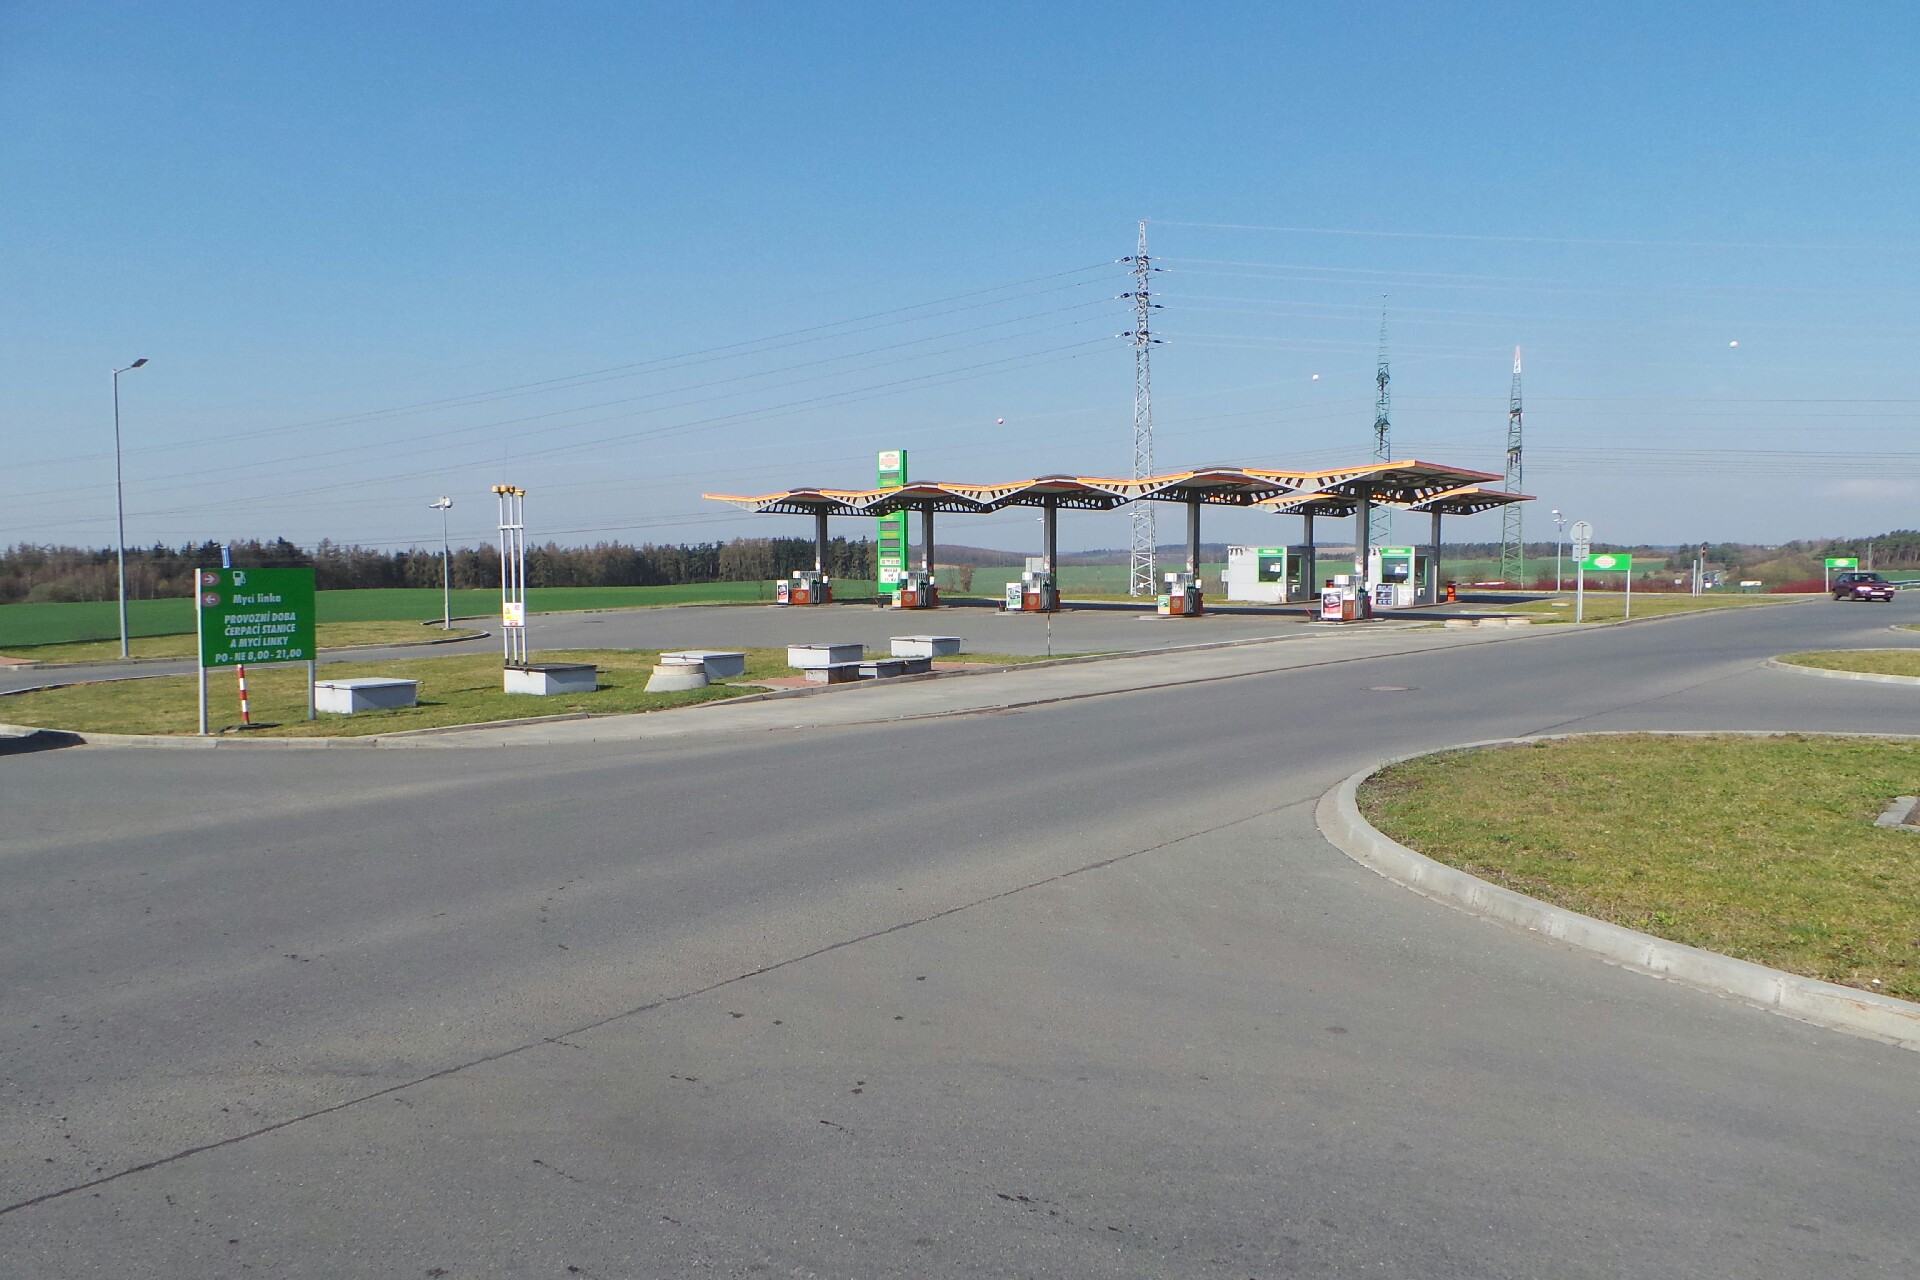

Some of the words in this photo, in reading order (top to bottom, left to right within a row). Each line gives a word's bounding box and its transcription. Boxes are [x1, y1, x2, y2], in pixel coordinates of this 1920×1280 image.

[257, 593, 281, 603] linka
[224, 611, 270, 624] PROVOZNÍ
[272, 612, 296, 622] DOBA
[225, 623, 260, 635] ČERPACÍ
[262, 623, 296, 634] STANICE
[230, 639, 237, 648] A
[238, 635, 262, 648] MYCÍ
[263, 637, 289, 646] LINKY
[215, 653, 228, 663] PO
[234, 652, 246, 661] NE
[247, 650, 269, 662] 8,00
[276, 649, 302, 660] 21,00
